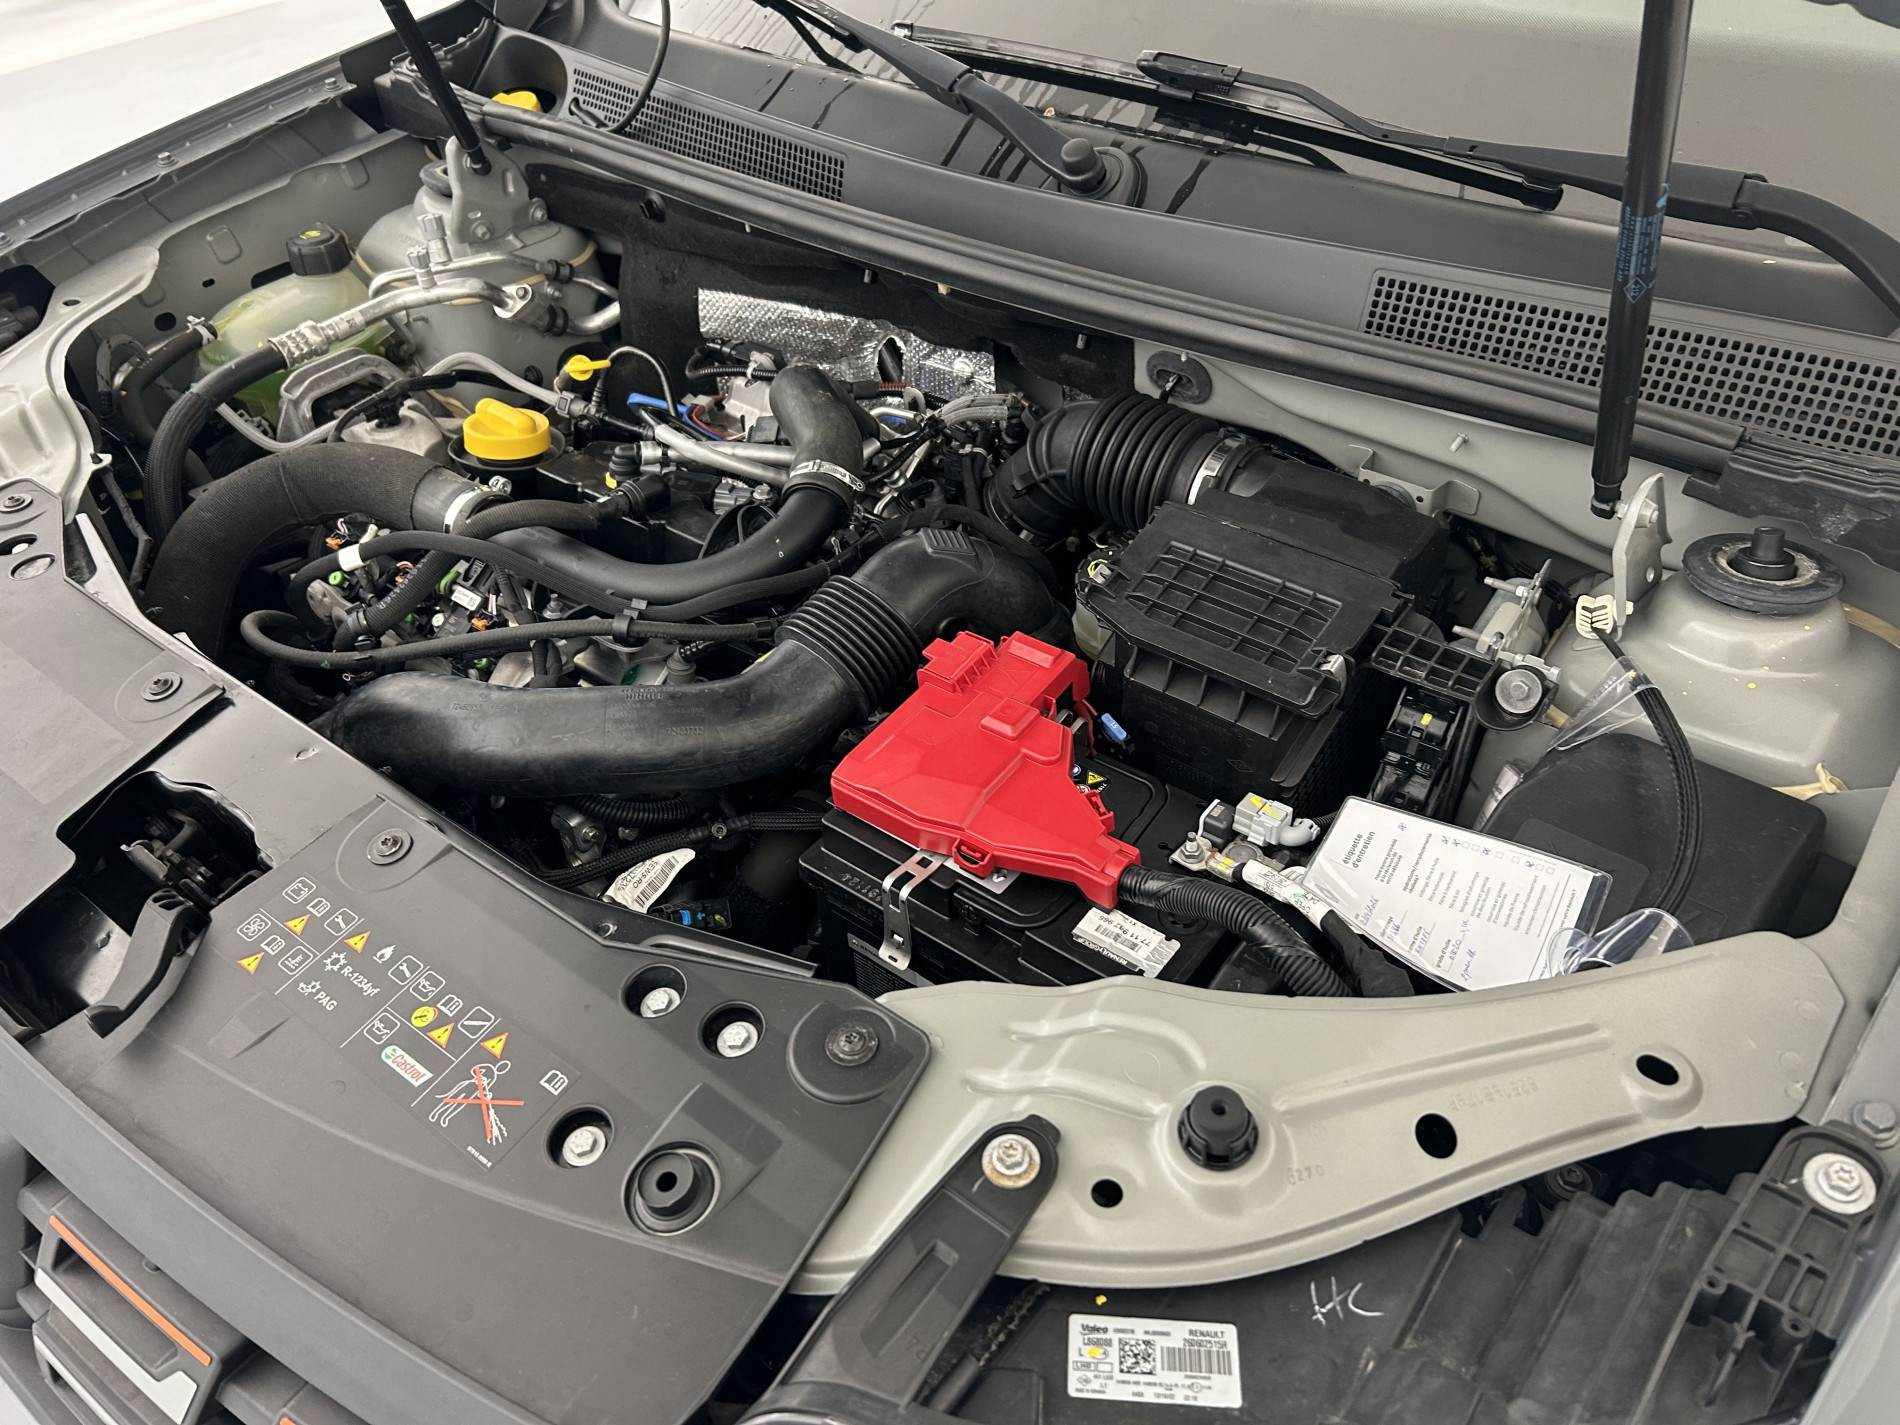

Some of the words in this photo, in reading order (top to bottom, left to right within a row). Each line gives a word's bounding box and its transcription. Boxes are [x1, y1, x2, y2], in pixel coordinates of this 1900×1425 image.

[1343, 832, 1363, 865] étiquette
[1352, 831, 1376, 869] d'entretien
[339, 964, 381, 998] R-1234yf
[314, 990, 338, 1012] PAG
[390, 1054, 427, 1083] Castrol
[1080, 1322, 1109, 1335] Valeo
[1188, 1328, 1225, 1339] RENAULT
